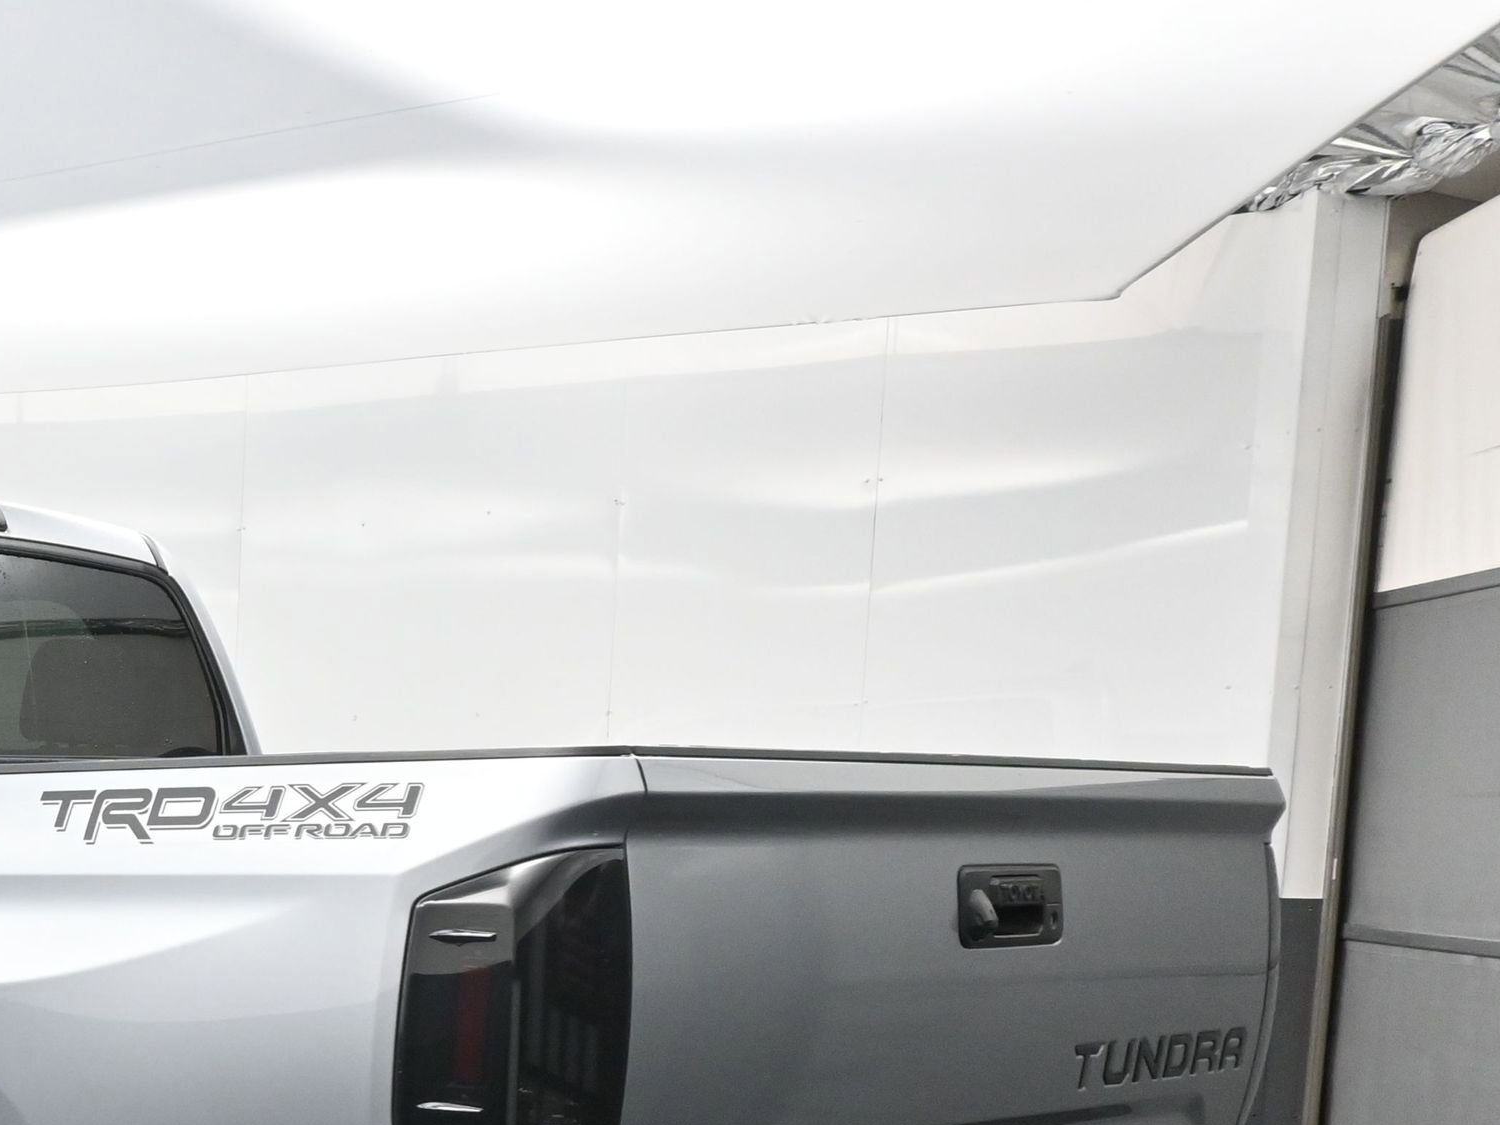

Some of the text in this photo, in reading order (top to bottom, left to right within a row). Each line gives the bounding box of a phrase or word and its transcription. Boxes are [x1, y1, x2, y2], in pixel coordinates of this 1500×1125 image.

[40, 782, 425, 845] TRD 4X4
[212, 821, 411, 842] OFF ROAD
[1074, 1026, 1248, 1092] TUNDRA
